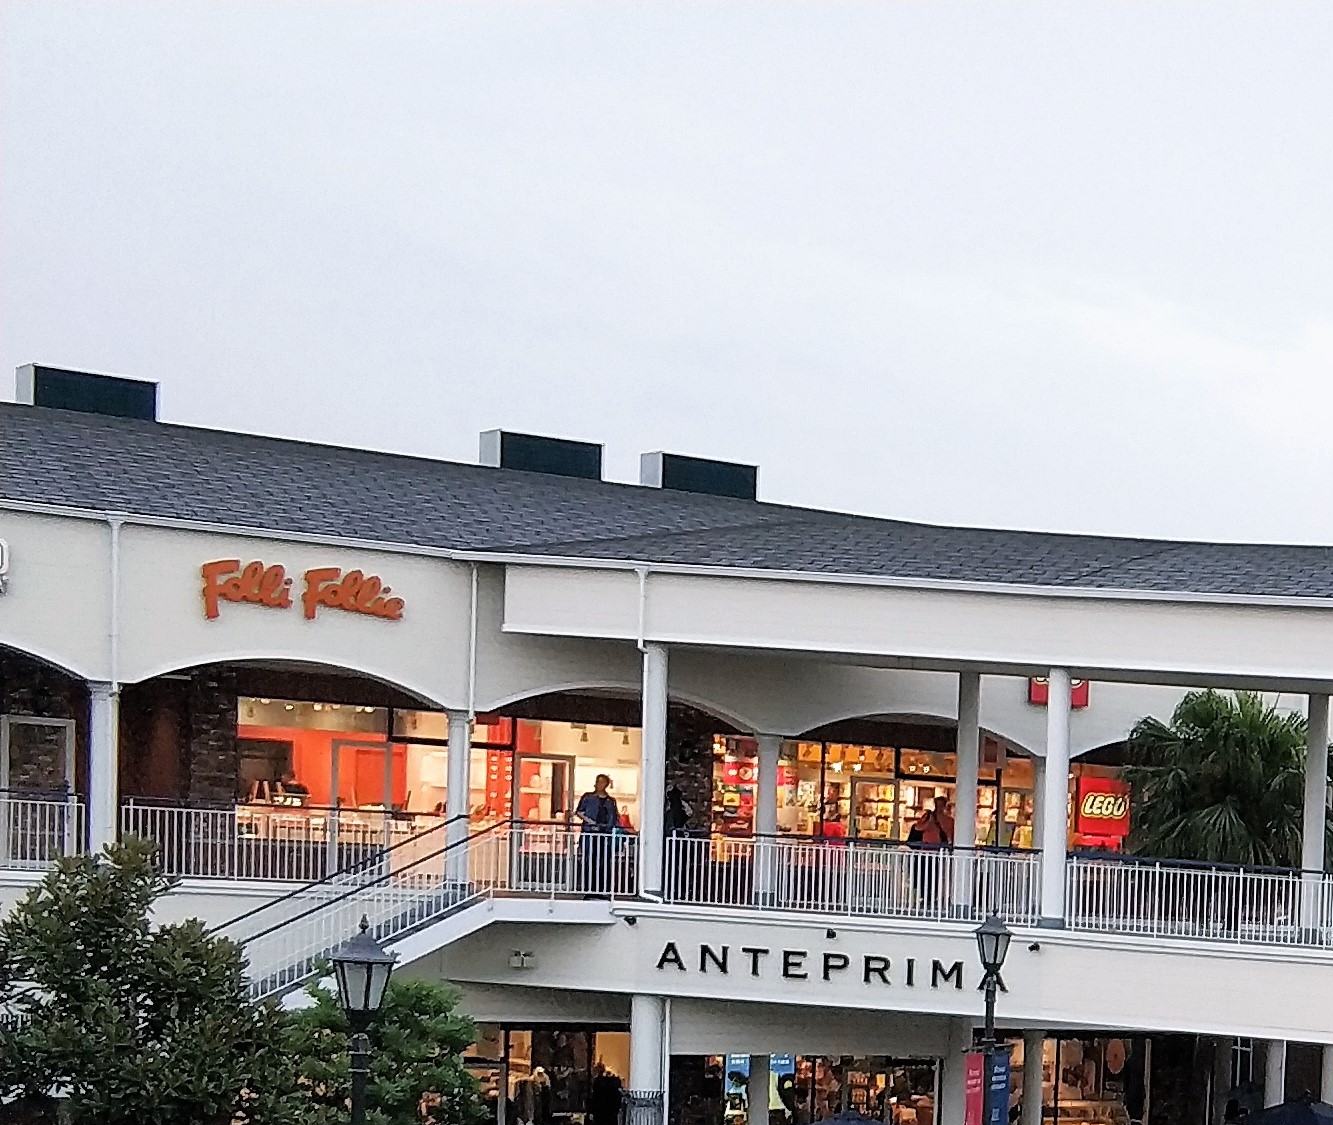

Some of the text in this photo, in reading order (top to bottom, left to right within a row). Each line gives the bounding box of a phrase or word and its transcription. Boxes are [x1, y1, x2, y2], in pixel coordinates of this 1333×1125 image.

[202, 559, 404, 620] Folli Follie
[1083, 792, 1128, 819] LEGO
